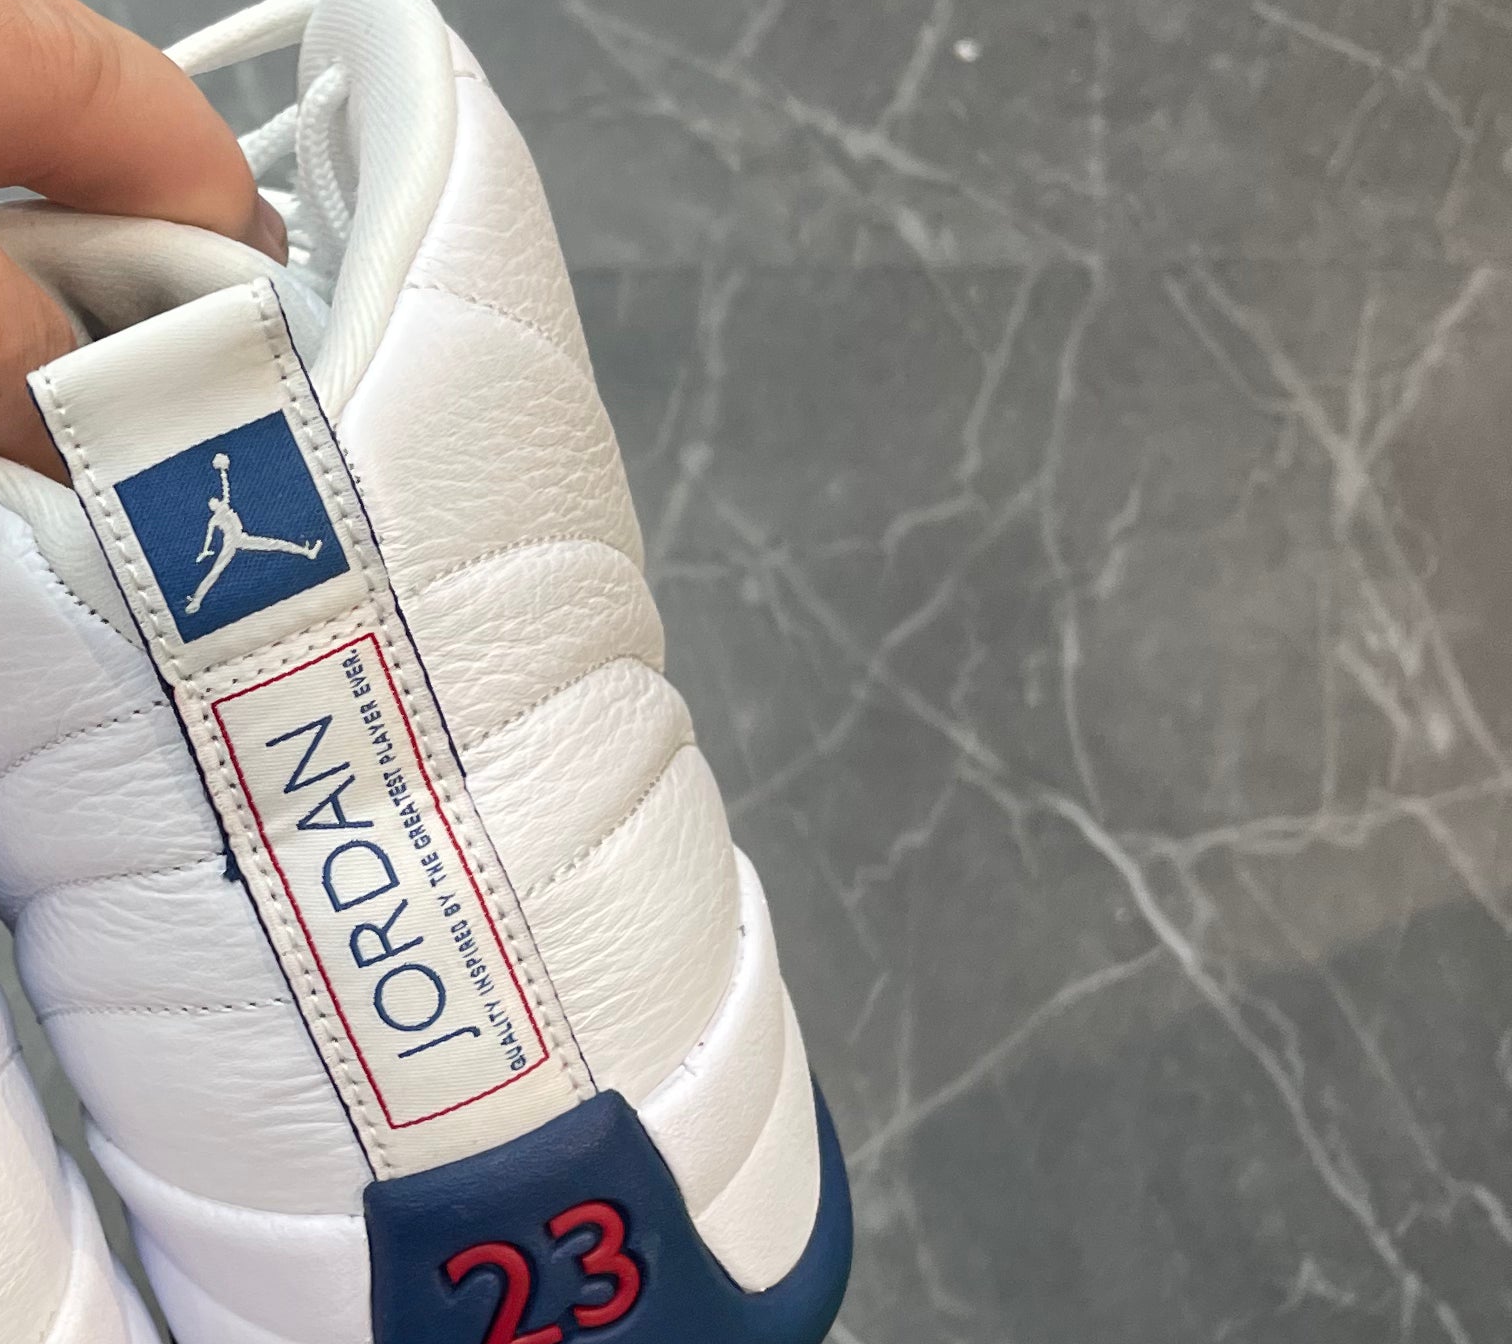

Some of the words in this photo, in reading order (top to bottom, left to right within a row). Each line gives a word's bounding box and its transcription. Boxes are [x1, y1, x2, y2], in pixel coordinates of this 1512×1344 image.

[341, 648, 371, 698] EVER.
[359, 699, 397, 765] PLAYER
[383, 767, 431, 850] GREATEST
[265, 714, 481, 1059] JORDAN
[420, 852, 447, 887] THE
[436, 892, 461, 917] BY
[450, 919, 495, 996] INSPIRED
[484, 1000, 526, 1071] QUALITY
